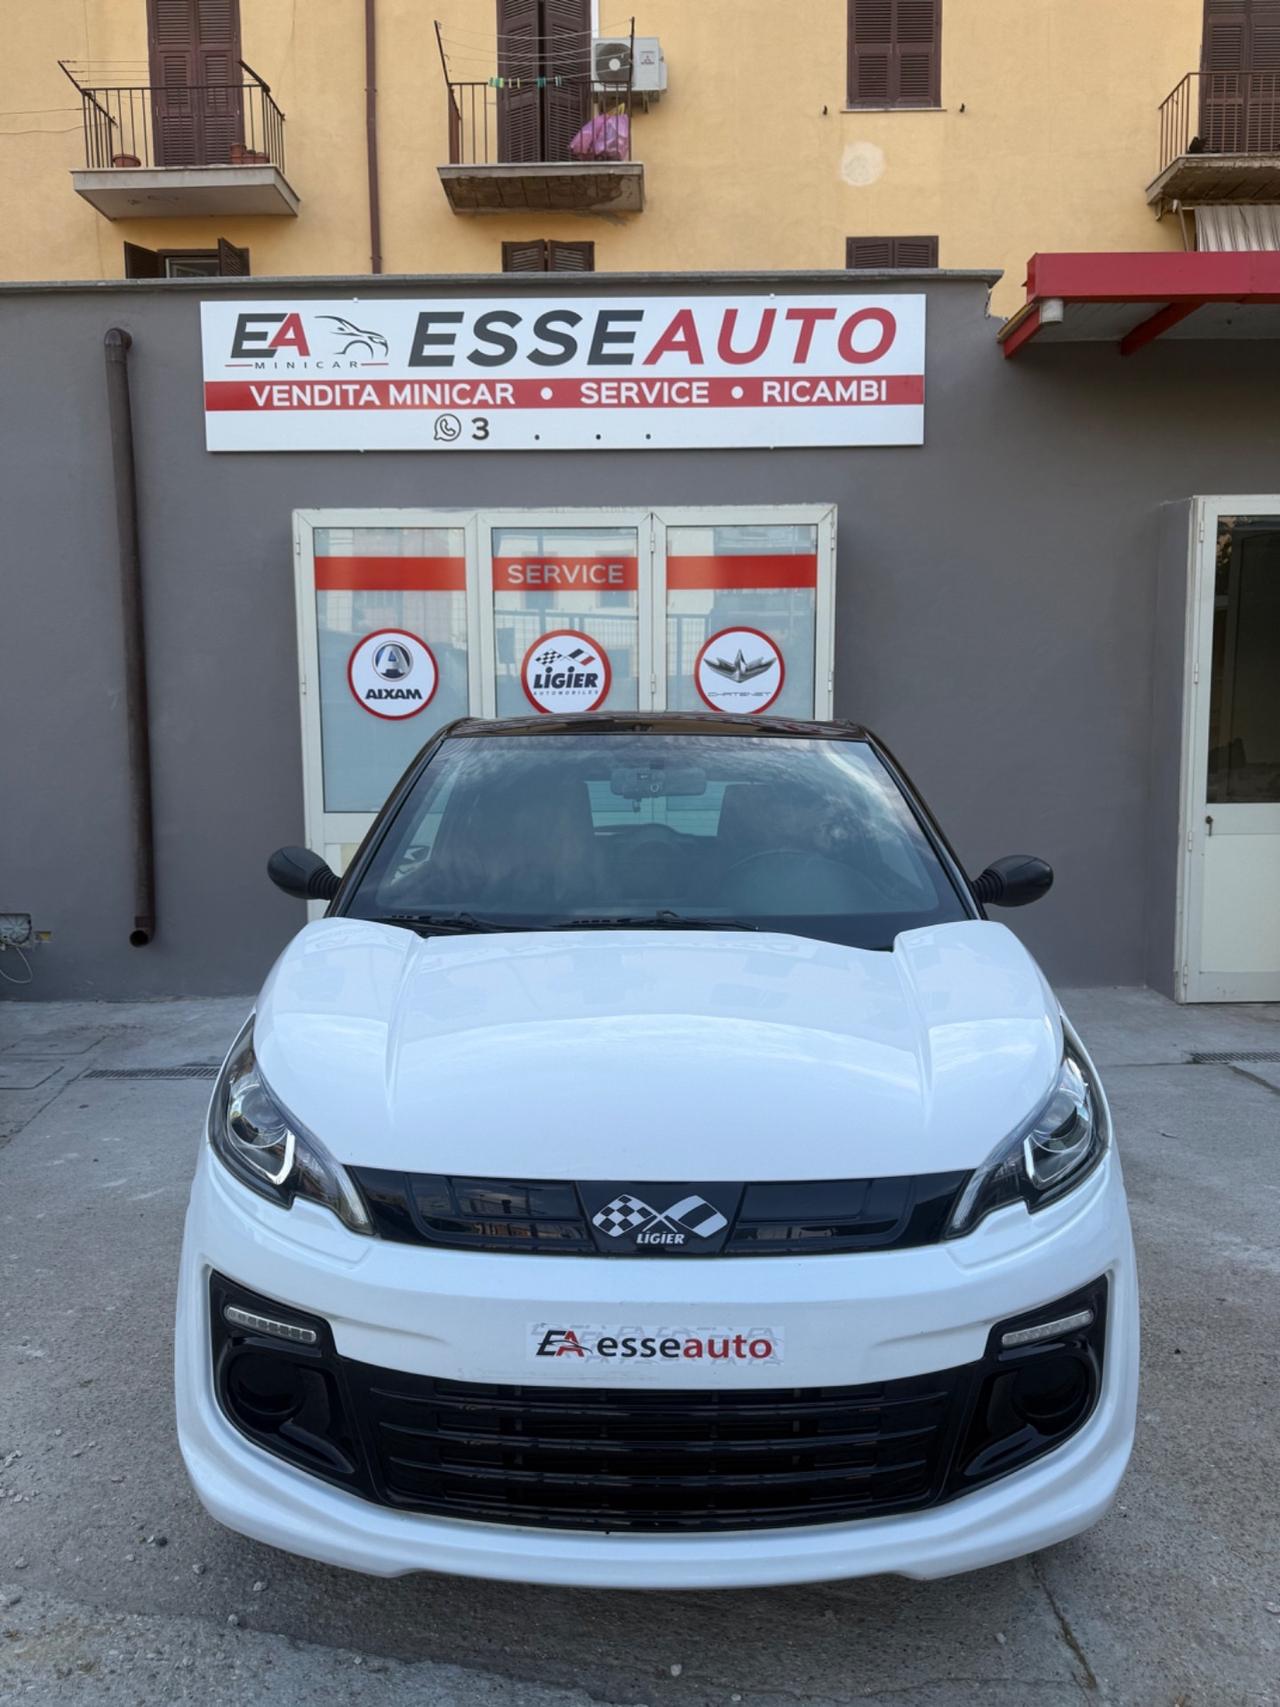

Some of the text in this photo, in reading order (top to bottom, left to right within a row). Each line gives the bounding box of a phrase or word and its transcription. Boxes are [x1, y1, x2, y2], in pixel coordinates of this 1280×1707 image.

[231, 313, 310, 358] EA
[408, 307, 897, 367] ESSEAUTO
[255, 361, 358, 369] MINICAR
[250, 380, 887, 407] VENDITA MINICAR SERVICE RICAMBI
[507, 564, 624, 584] SERVICE
[533, 666, 599, 689] LIGIER
[365, 688, 423, 700] AIXAM
[636, 1231, 685, 1244] LIGIER
[597, 1334, 773, 1359] esseauto
